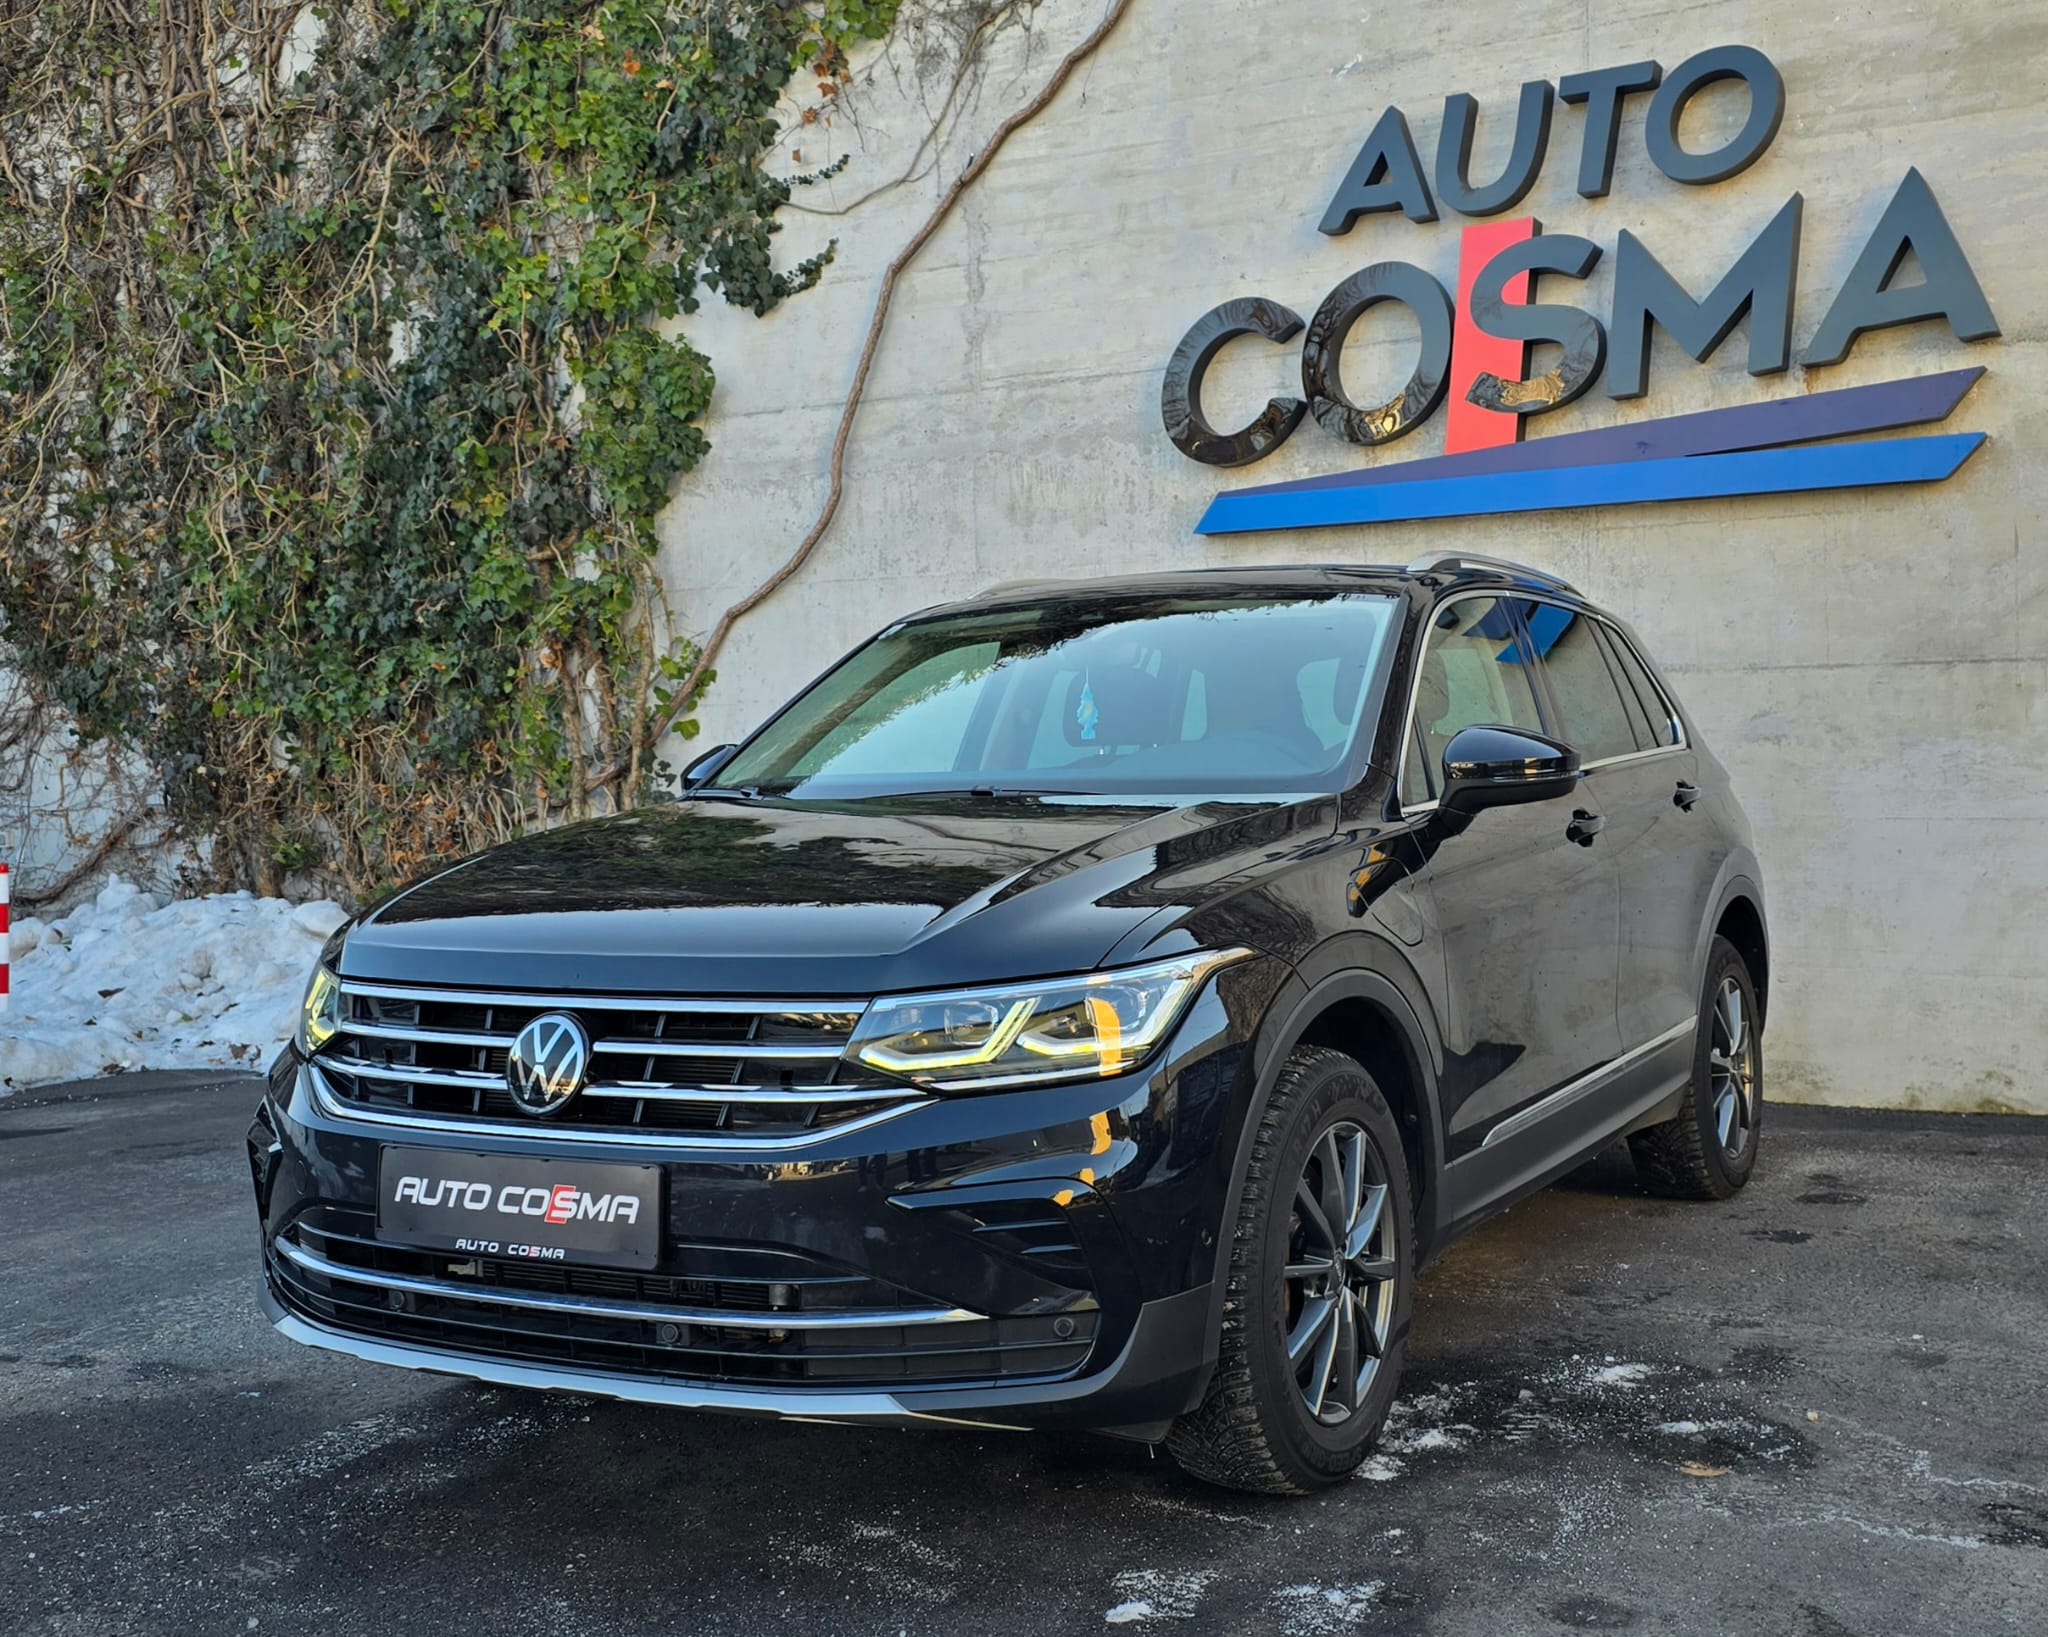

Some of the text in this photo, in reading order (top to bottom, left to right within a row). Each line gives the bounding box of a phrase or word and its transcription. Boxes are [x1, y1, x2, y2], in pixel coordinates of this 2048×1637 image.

[1317, 44, 1786, 237] AUTO
[1161, 165, 2002, 468] COSMA
[394, 1175, 640, 1225] AUTO COSMA
[455, 1238, 566, 1260] AUTO COSMA
